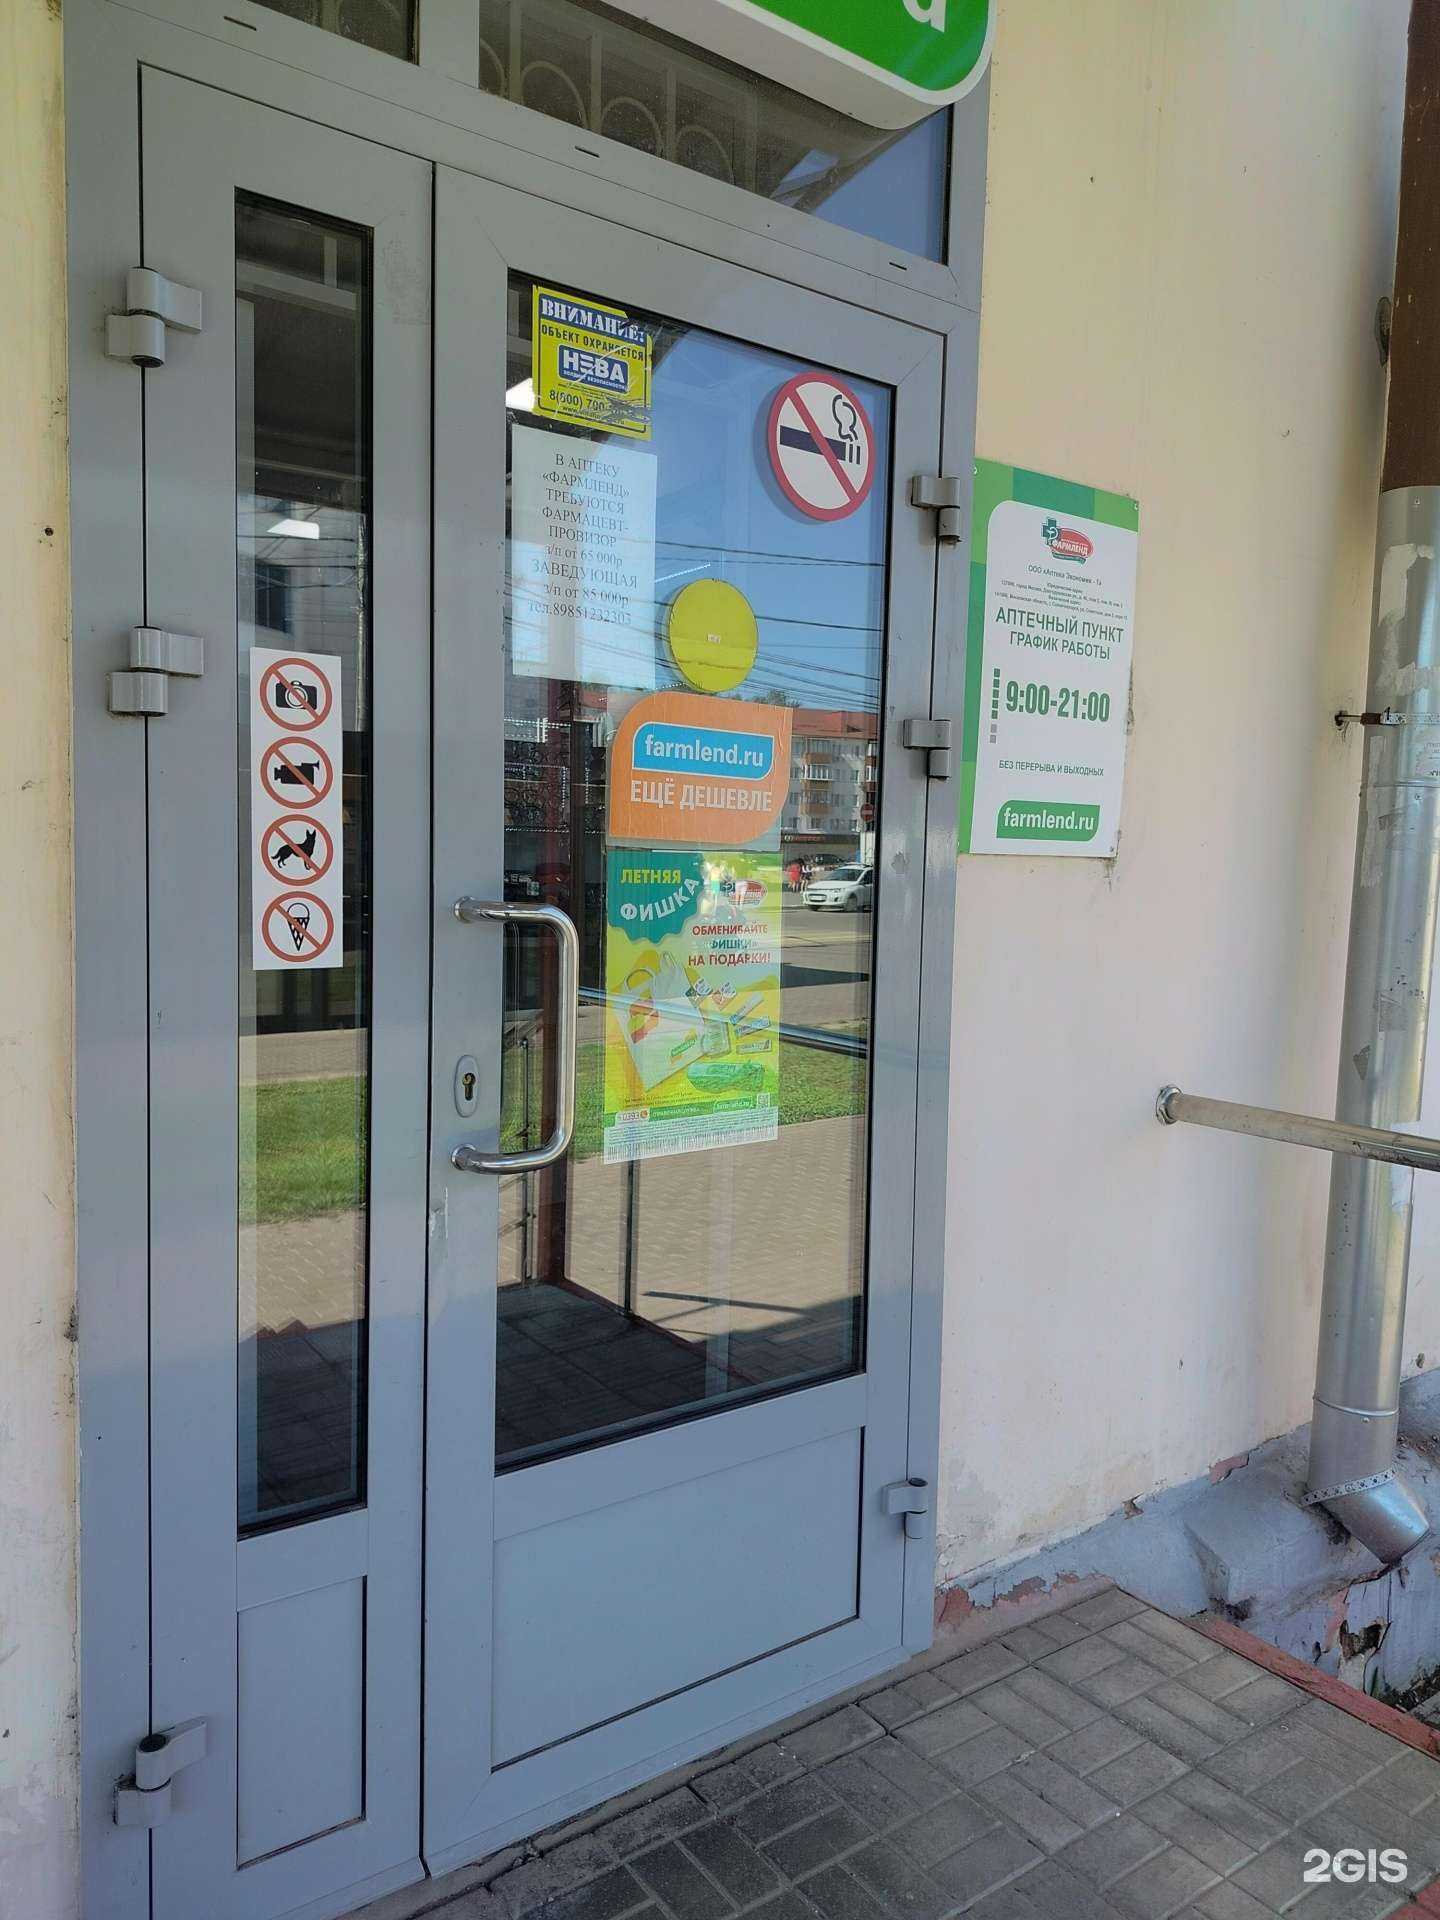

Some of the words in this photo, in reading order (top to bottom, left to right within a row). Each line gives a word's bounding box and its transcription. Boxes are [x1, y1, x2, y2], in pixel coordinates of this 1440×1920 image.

[541, 324, 580, 347] ОБЪЕКТ
[583, 335, 644, 362] ОХРАНЯЕТСЯ
[556, 453, 564, 466] В
[568, 457, 620, 477] АПТЕКУ
[542, 471, 630, 498] «ФАРМЛЕНД»
[546, 487, 624, 515] ТРЕБУЮТСЯ
[549, 525, 617, 547] ПРОВИЗОР
[565, 549, 578, 559] от
[531, 559, 638, 589] ЗАВЕДУЮЩАЯ
[1028, 564, 1042, 574] ООО
[565, 588, 579, 599] от
[996, 606, 1078, 635] АПТЕЧНЫЙ
[1082, 621, 1124, 643] ПУНКТ
[1010, 630, 1058, 652] ГРАФИК
[1061, 640, 1110, 660] РАБОТЫ
[1006, 680, 1110, 722] 9:00-21:00
[645, 734, 763, 767] farmlend.ru
[999, 760, 1014, 769] БЕЗ
[1015, 762, 1056, 773] ПЕРЕРЫВА
[1064, 768, 1104, 776] ВЫХОДНЫХ
[630, 777, 676, 808] ЕЩЁ
[679, 784, 773, 812] ДЕШЕВЛЕ
[1004, 807, 1094, 831] farmlend.ru
[620, 869, 682, 884] ЛЕТНЯЯ
[620, 878, 700, 922] ФИШКА
[692, 920, 768, 936] ОБМЕНИВАЙТЕ
[688, 955, 705, 966] НА
[709, 952, 771, 967] ПОДАРКИ!
